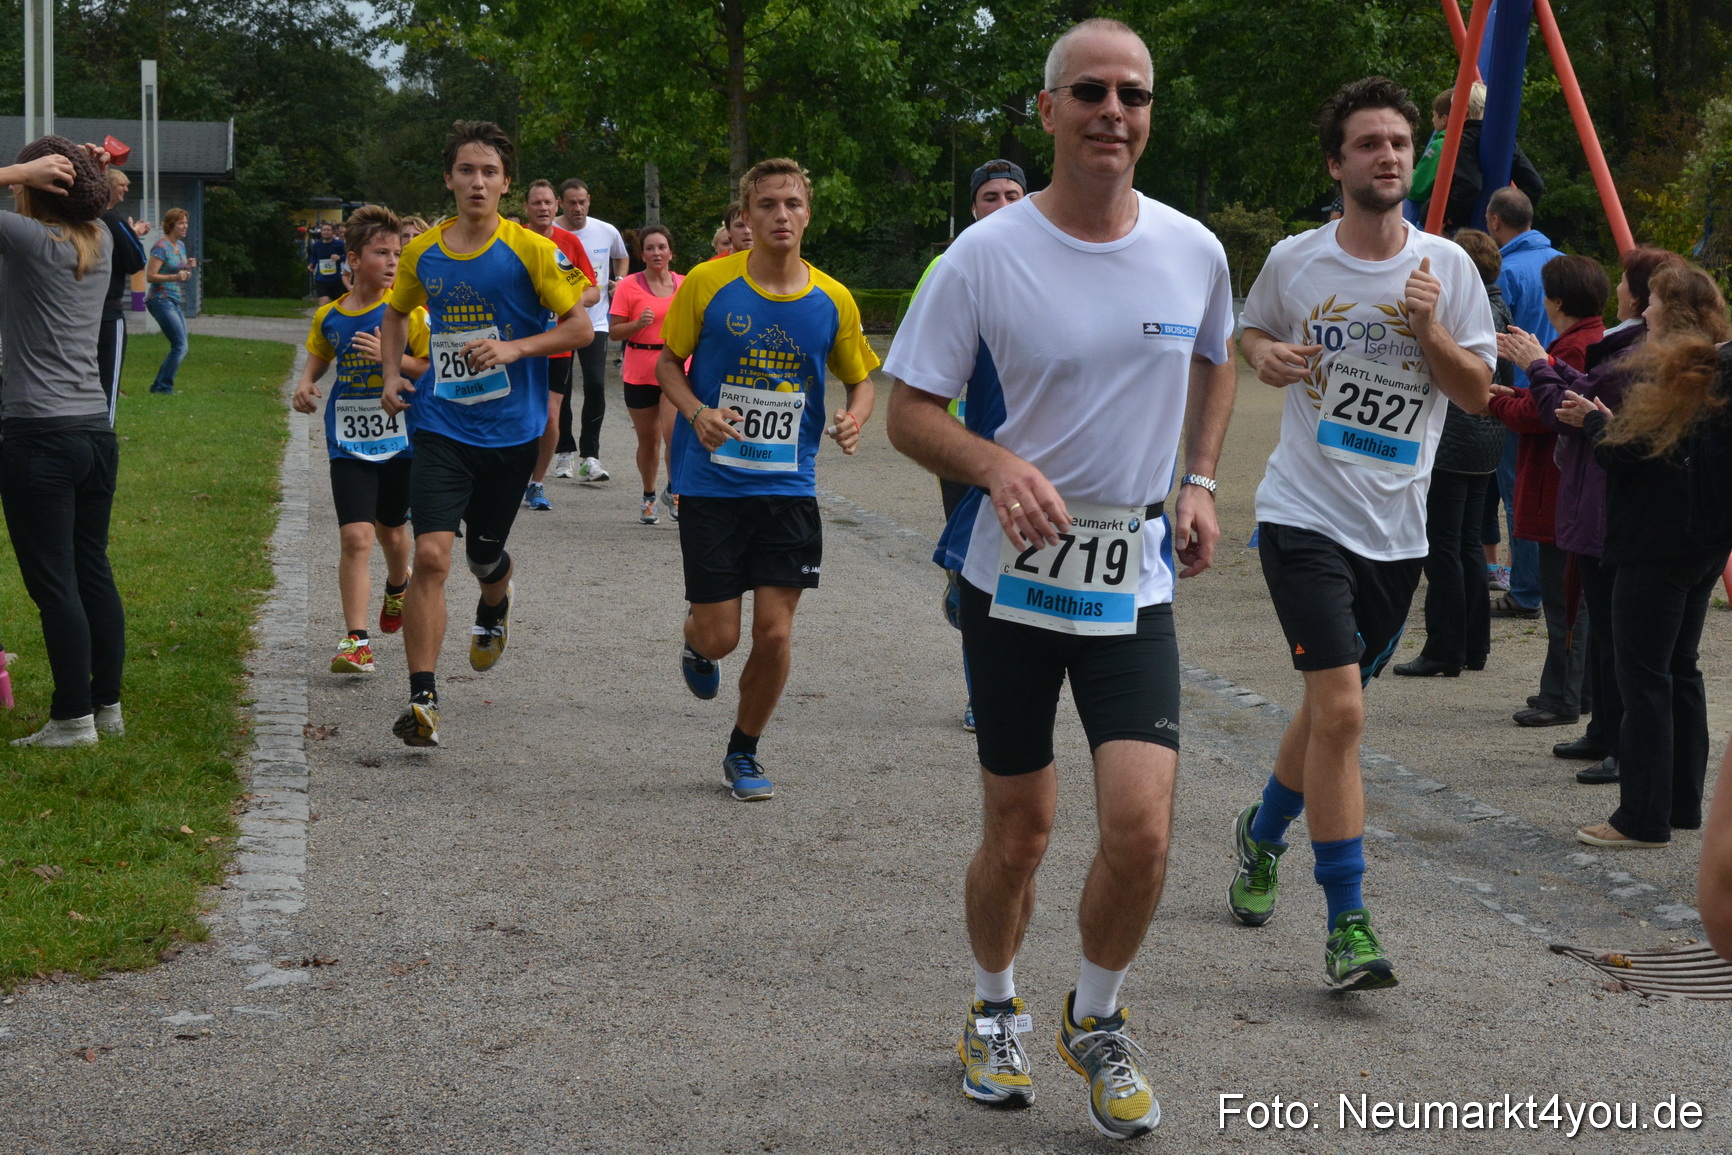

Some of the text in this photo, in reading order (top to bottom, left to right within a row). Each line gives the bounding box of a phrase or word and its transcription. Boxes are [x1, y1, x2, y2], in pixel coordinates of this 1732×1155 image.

[566, 269, 582, 283] PAR
[432, 341, 450, 349] PARTL
[1312, 325, 1346, 351] 10.
[440, 350, 497, 379] 260
[455, 382, 485, 396] Patrik
[1335, 363, 1422, 393] PARTL Neumarkt
[721, 391, 791, 408] PARTL Neumarkt
[1331, 382, 1424, 435] 2527
[343, 414, 399, 438] 3334
[739, 444, 772, 460] Oliver
[1341, 431, 1398, 459] Mathias
[1071, 516, 1123, 531] eumarkt
[1014, 531, 1128, 586] 2719
[1026, 587, 1104, 617] Matthias
